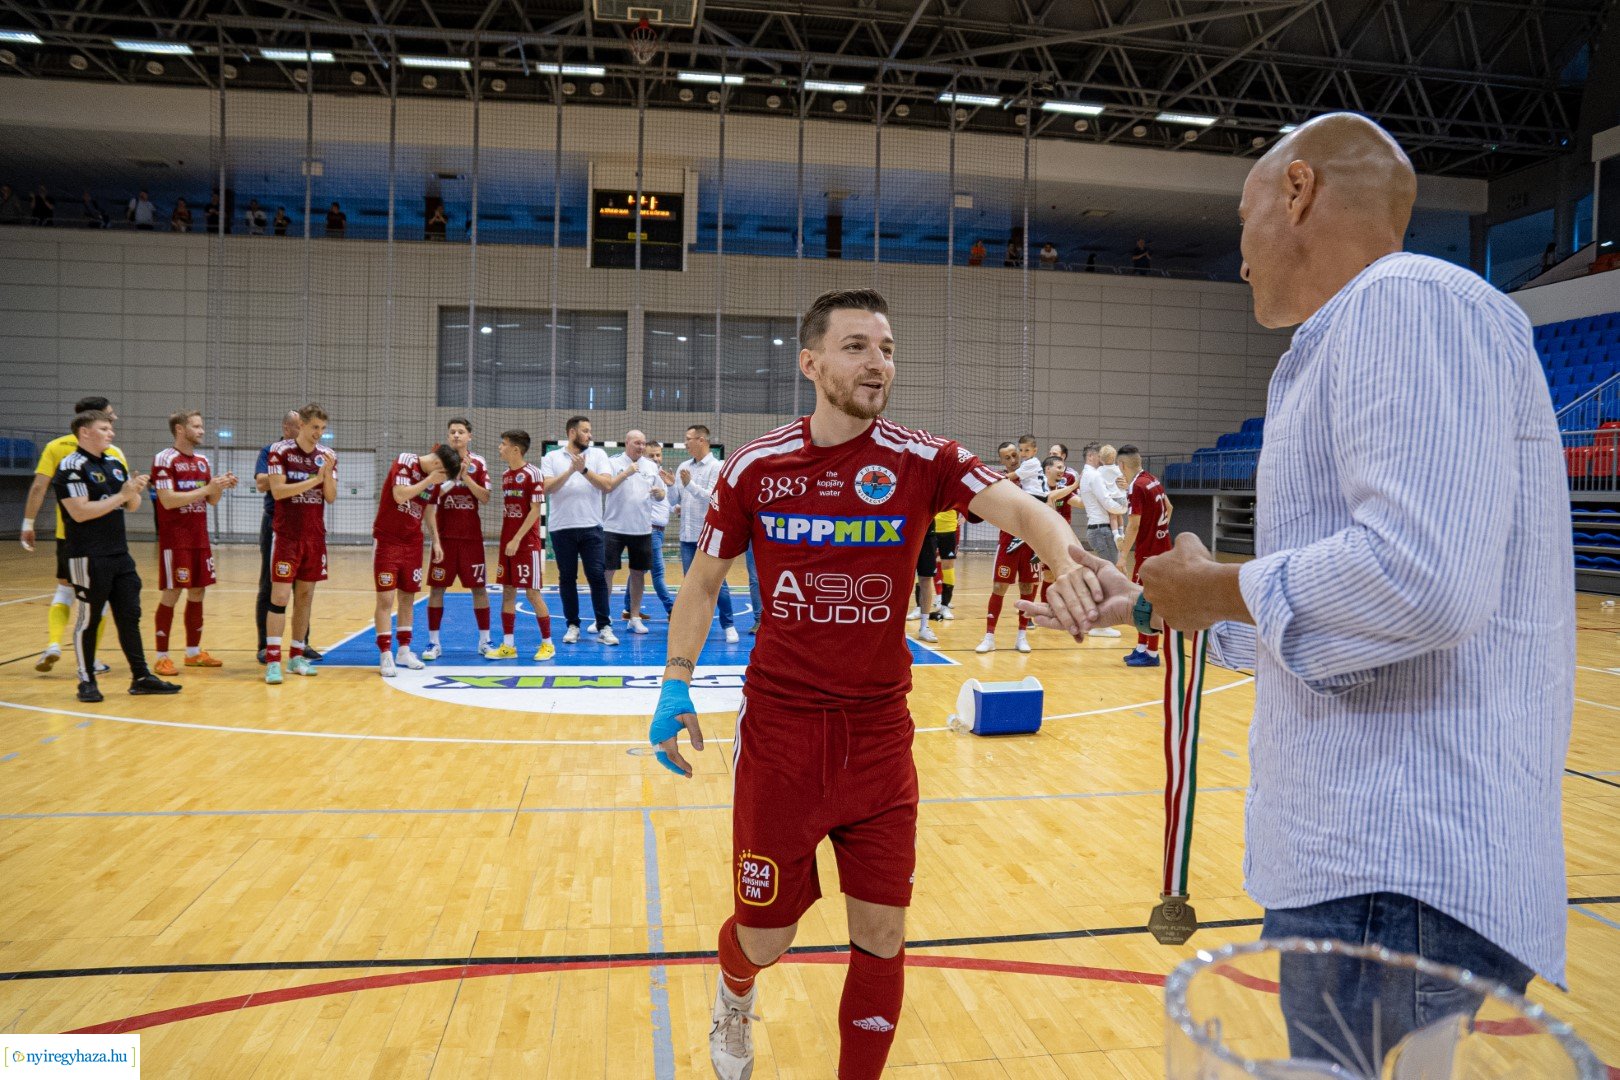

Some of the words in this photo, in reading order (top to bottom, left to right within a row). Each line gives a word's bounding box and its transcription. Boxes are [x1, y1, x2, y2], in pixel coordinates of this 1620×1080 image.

[825, 470, 838, 478] the
[758, 476, 808, 504] 383
[471, 563, 485, 578] 77
[516, 564, 530, 578] 13
[771, 600, 891, 624] STUDIO
[743, 861, 771, 880] 99.4
[741, 875, 770, 888] SUNSHINE
[745, 885, 761, 899] FM
